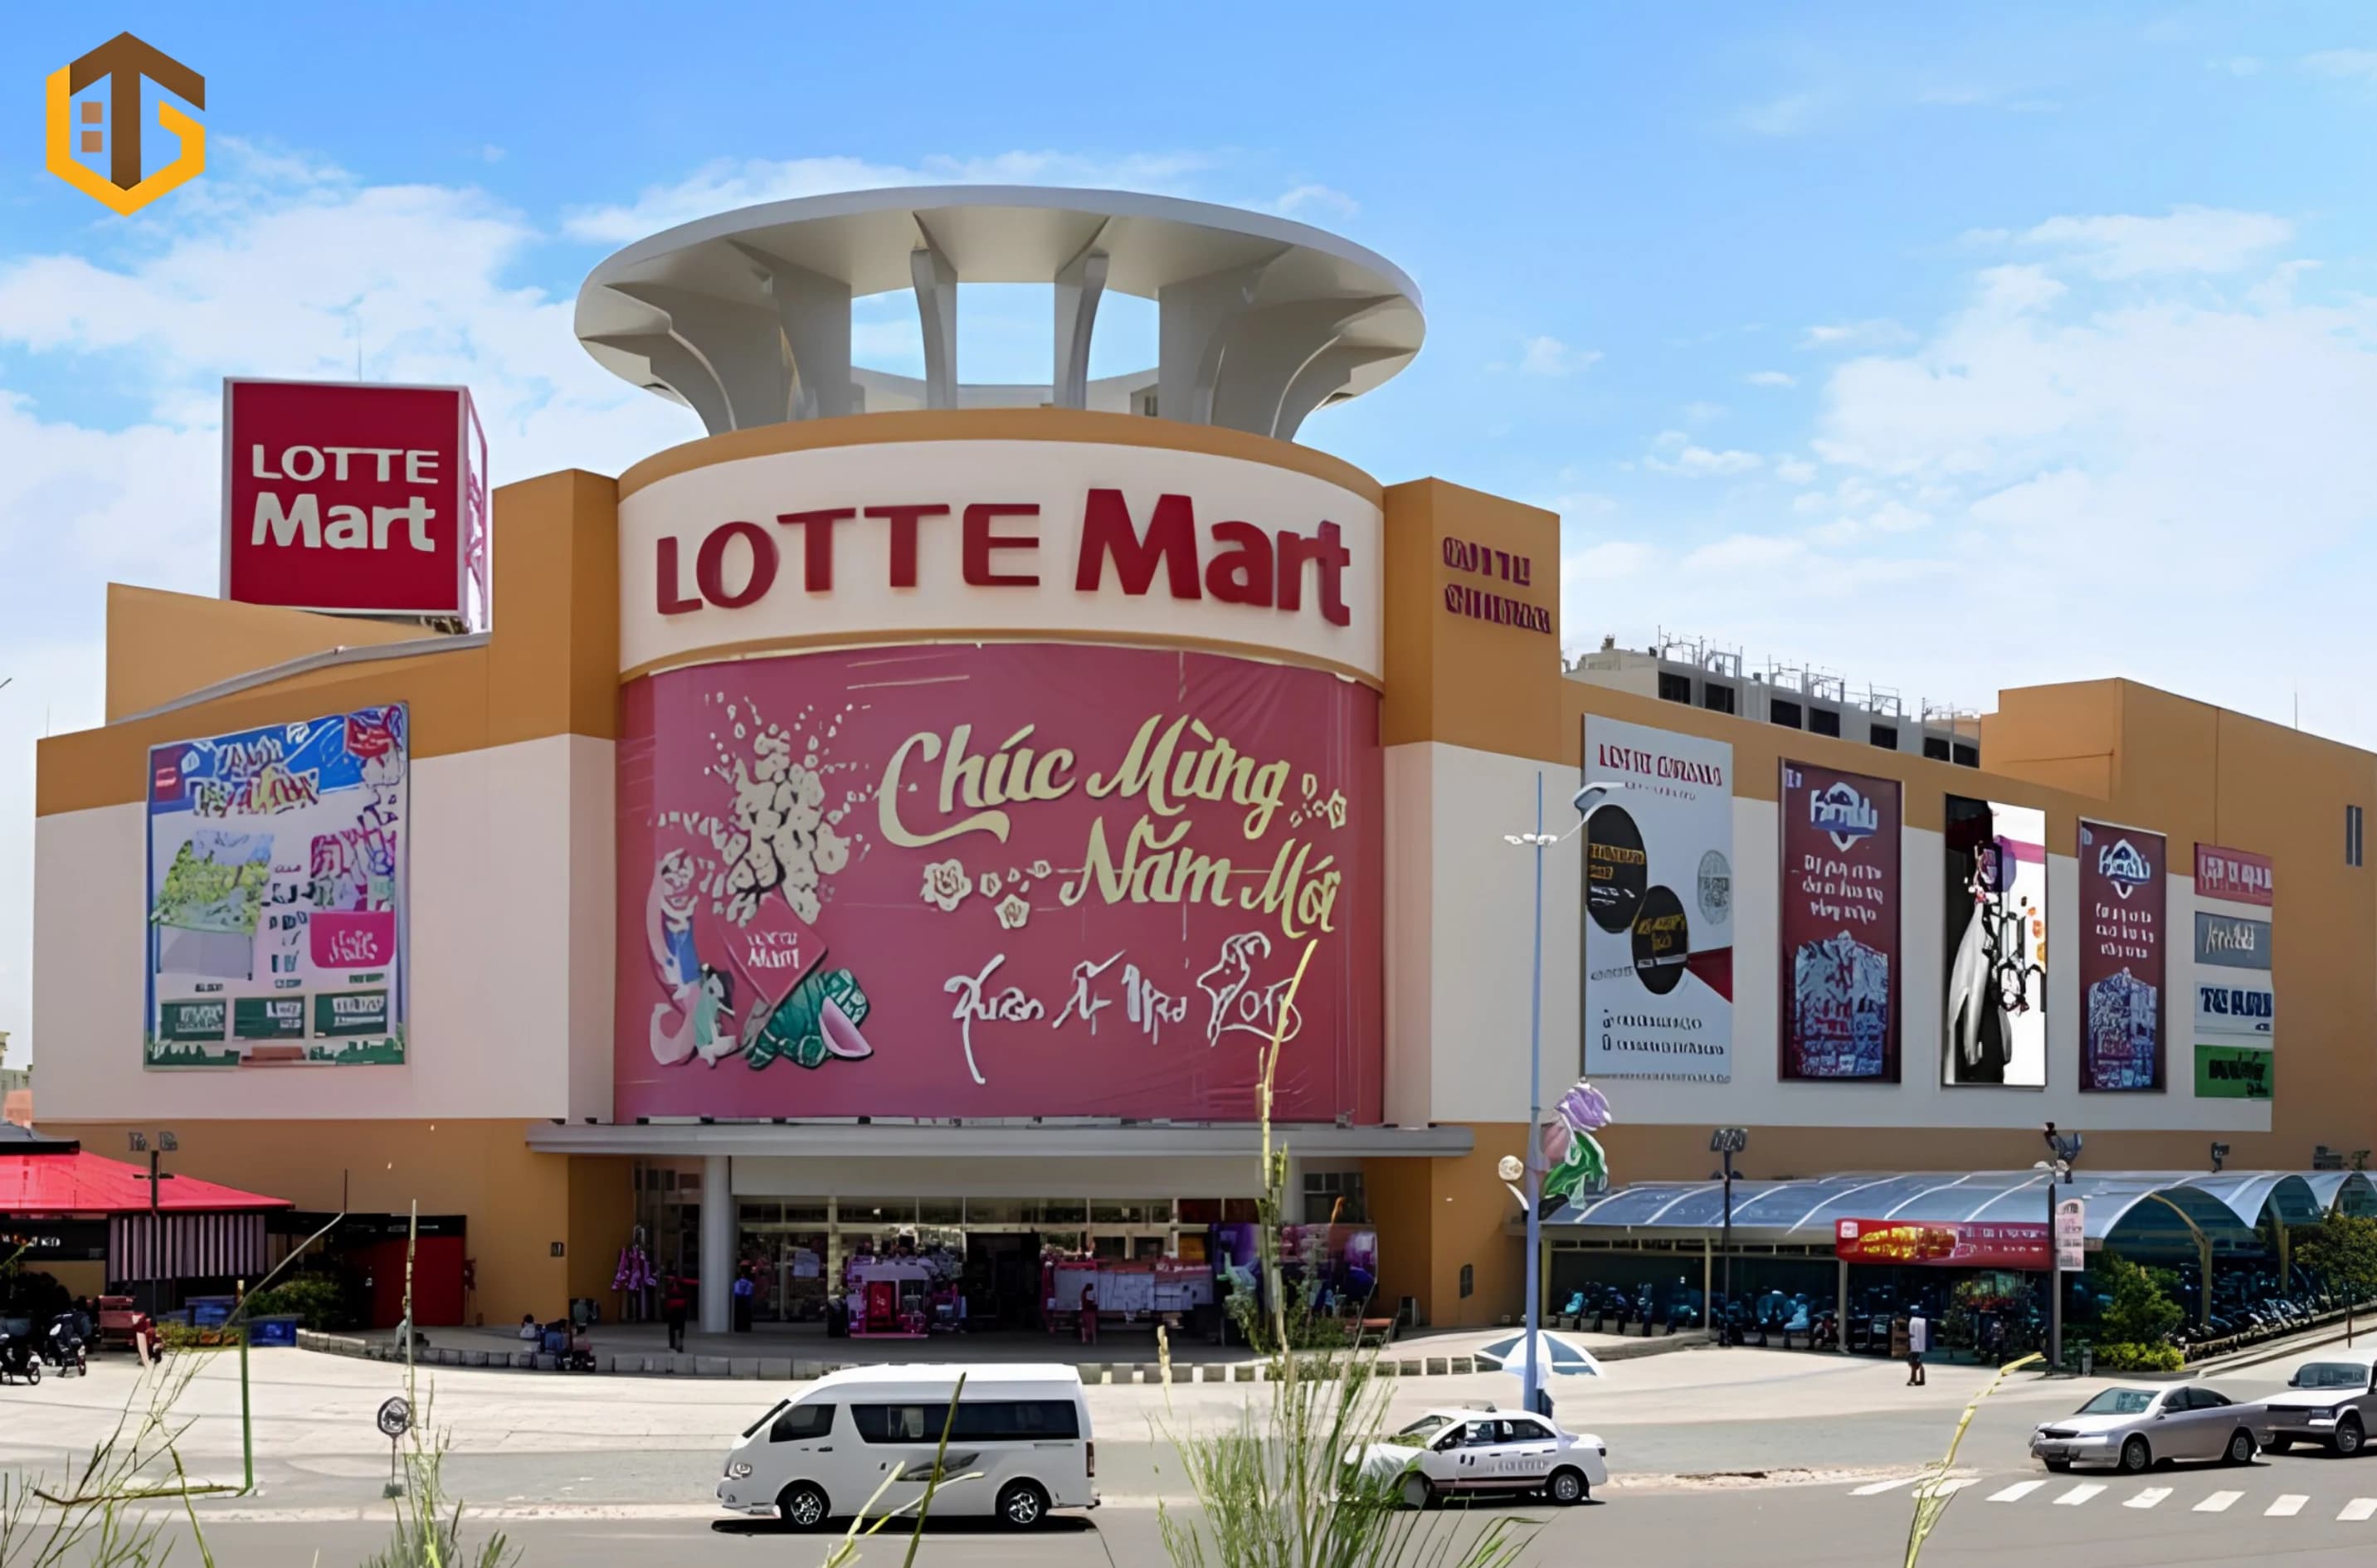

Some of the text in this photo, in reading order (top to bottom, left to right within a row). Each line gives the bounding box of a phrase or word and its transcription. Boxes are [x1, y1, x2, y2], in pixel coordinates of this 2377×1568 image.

[251, 444, 440, 485] LOTTE
[251, 491, 436, 553] Mart
[656, 503, 1041, 616] LOTTE
[1074, 488, 1351, 627] Mart
[877, 713, 1291, 849] Chúc Mừng
[1059, 814, 1234, 908] Năm
